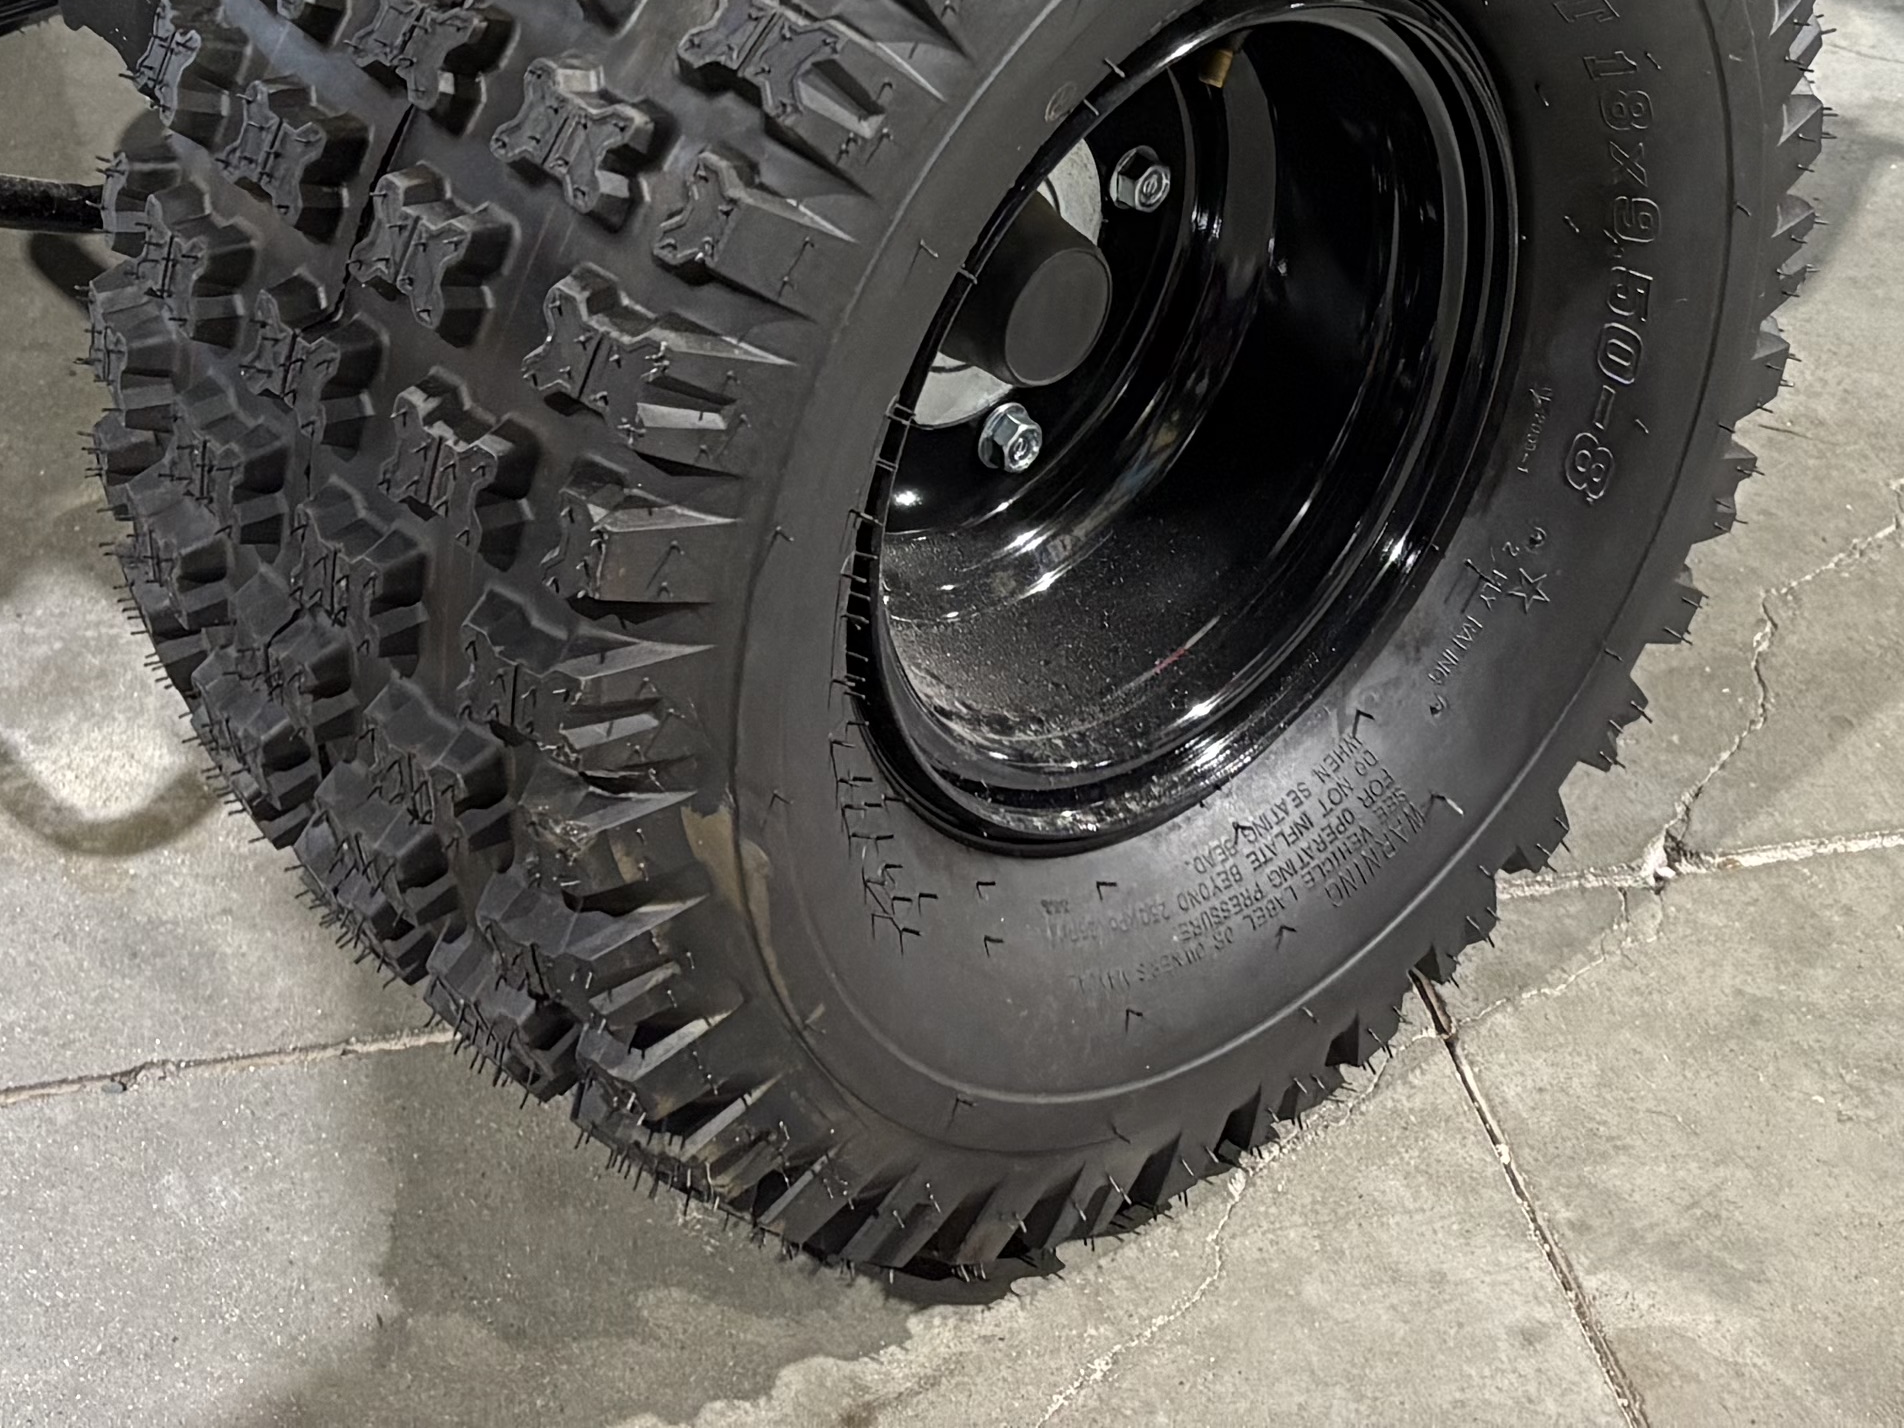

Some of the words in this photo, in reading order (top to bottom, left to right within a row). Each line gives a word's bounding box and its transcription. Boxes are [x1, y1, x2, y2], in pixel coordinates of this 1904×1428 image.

[1311, 731, 1364, 785] WHEN
[1354, 748, 1379, 777] DO
[1241, 780, 1313, 843] SEATING
[1317, 775, 1355, 819] NOT
[1356, 767, 1396, 810] FOR
[1245, 812, 1315, 871] INFLATE
[1266, 807, 1357, 889] OPERATING
[1300, 822, 1379, 890] VEHICLE
[1324, 800, 1427, 909] WARNING
[1176, 862, 1244, 912] BEYOND
